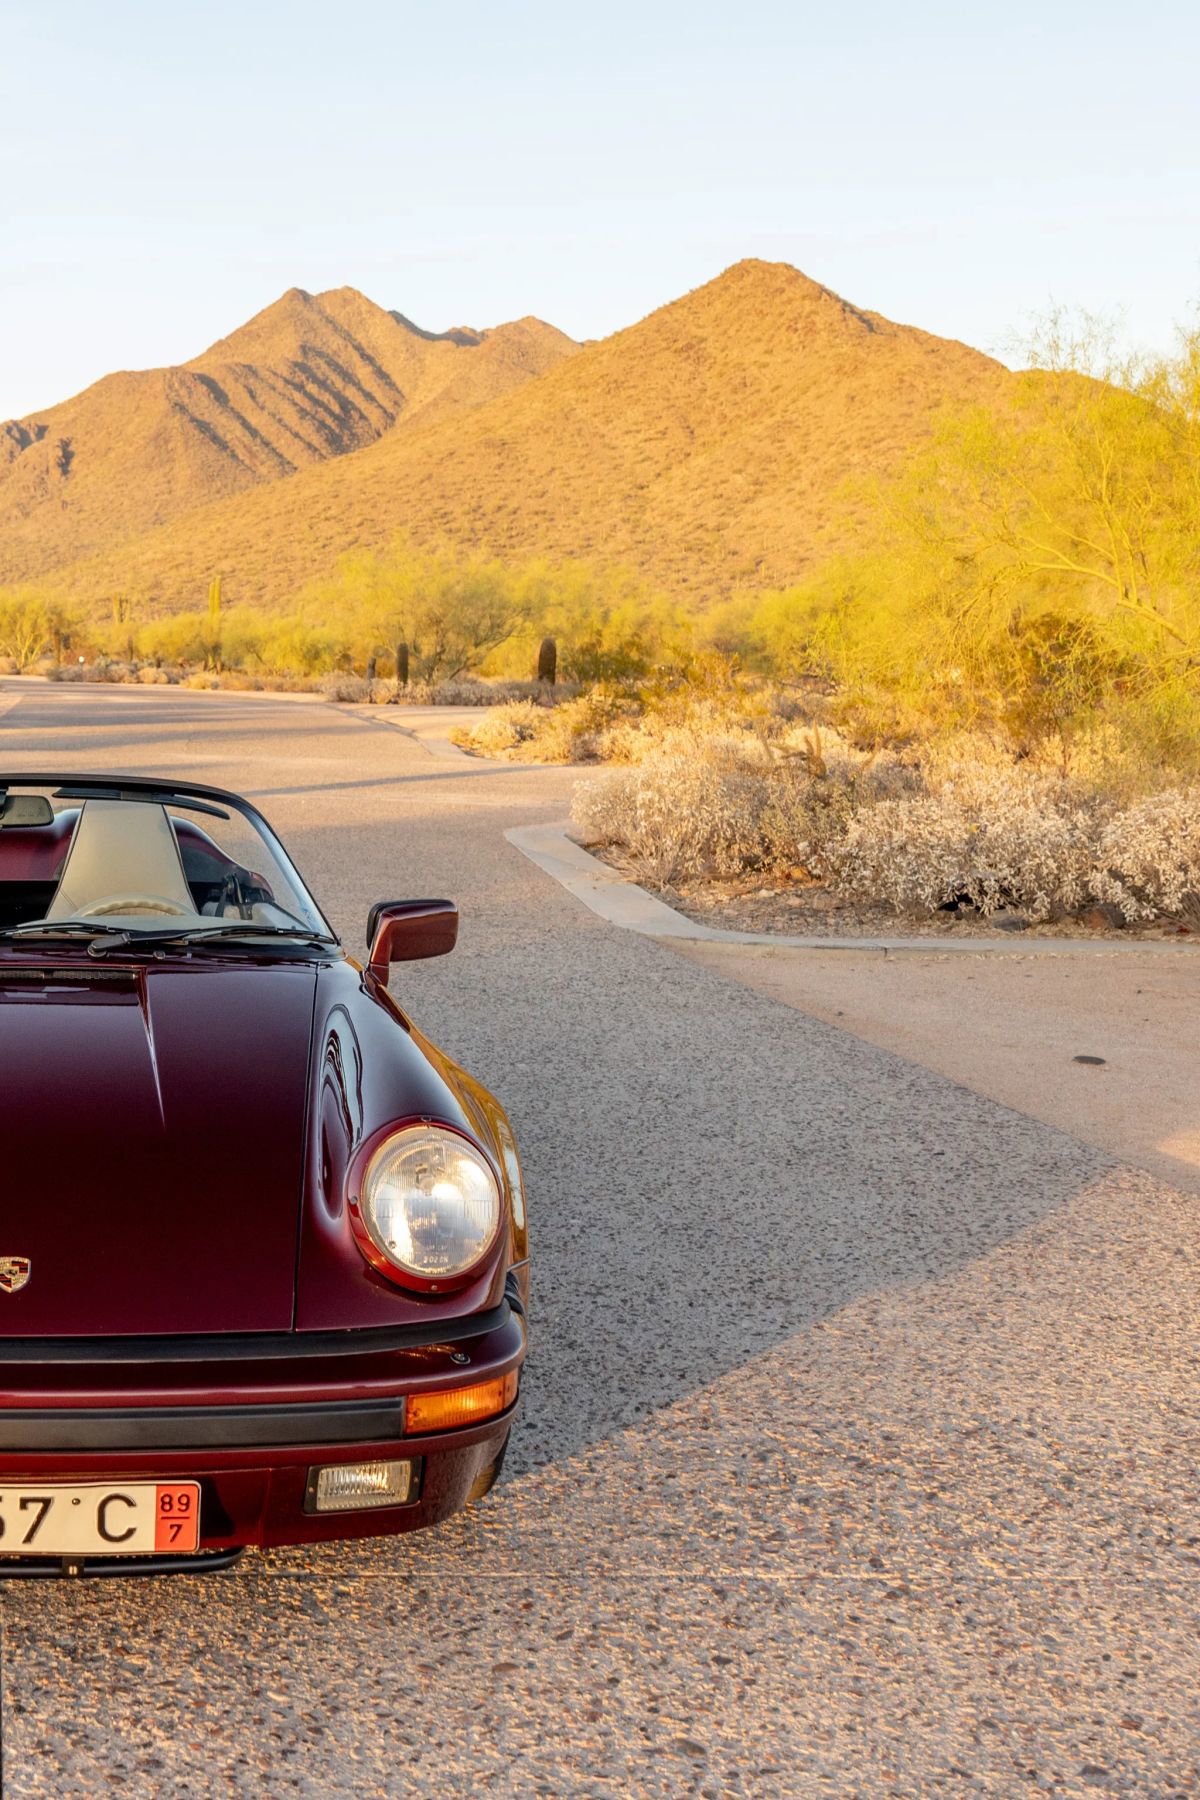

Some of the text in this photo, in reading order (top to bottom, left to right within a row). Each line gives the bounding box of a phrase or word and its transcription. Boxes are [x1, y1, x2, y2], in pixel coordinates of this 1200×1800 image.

[160, 1493, 191, 1513] 89
[97, 1492, 137, 1543] C
[169, 1523, 183, 1543] 7
